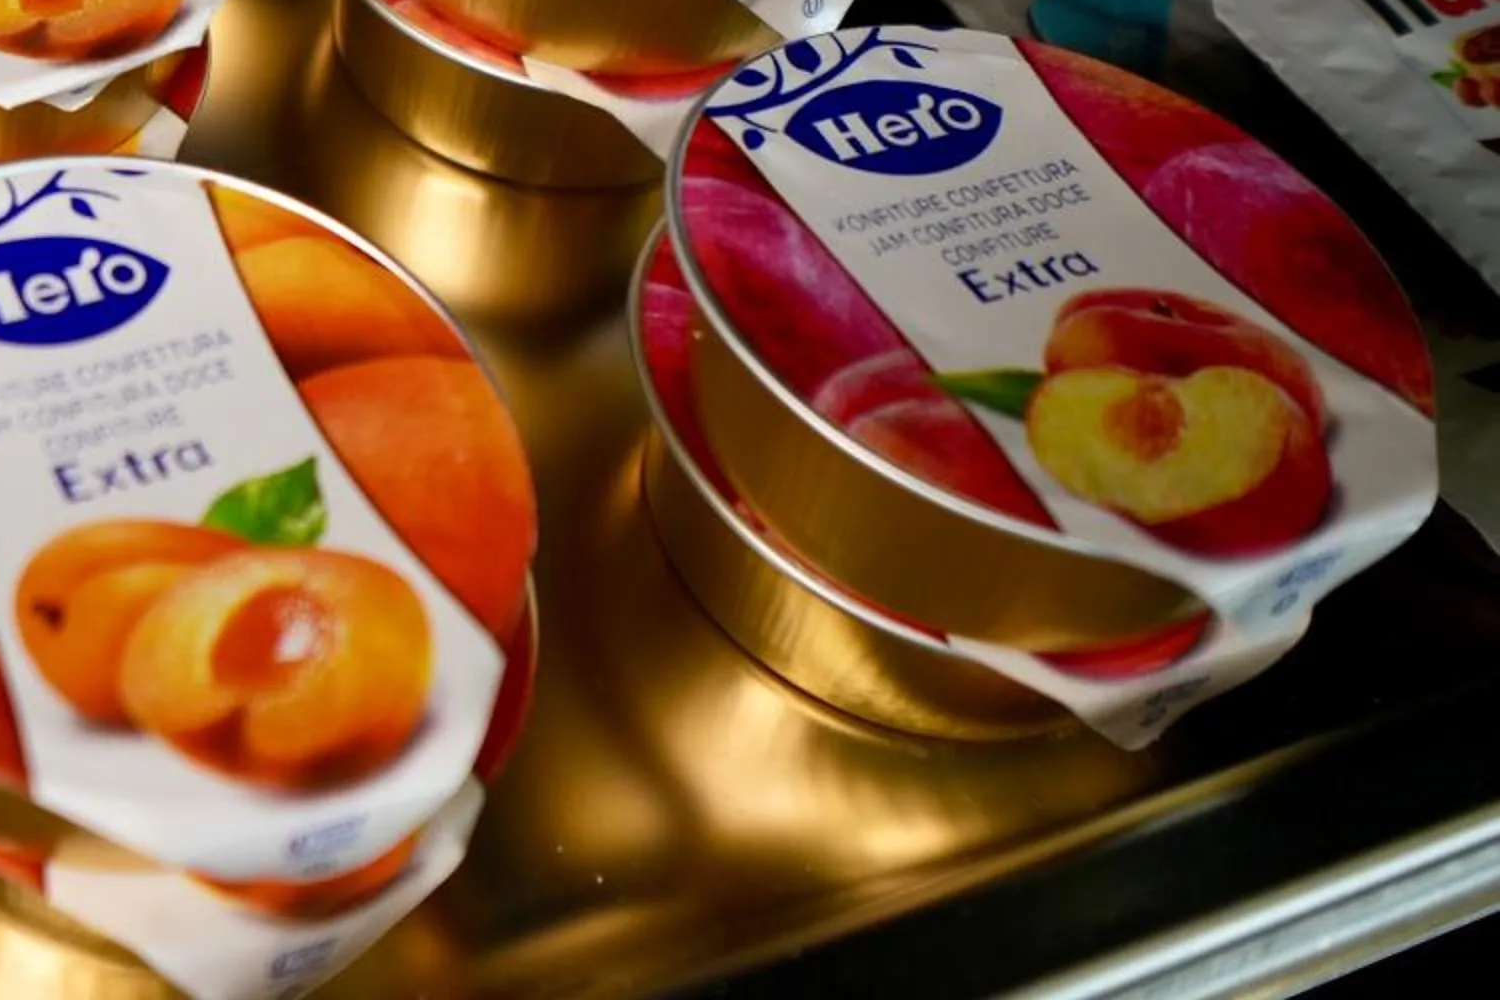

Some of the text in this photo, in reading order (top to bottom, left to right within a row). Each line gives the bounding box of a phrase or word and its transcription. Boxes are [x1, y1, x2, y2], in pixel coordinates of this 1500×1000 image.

[812, 93, 982, 161] Hero
[834, 159, 1080, 233] KONFITURE CONFETTURA
[912, 201, 1029, 246] CONFITURA
[1027, 183, 1092, 216] DOCE
[941, 222, 1061, 267] CONFITURE
[956, 251, 1099, 305] Extra
[53, 440, 214, 504] Extra
